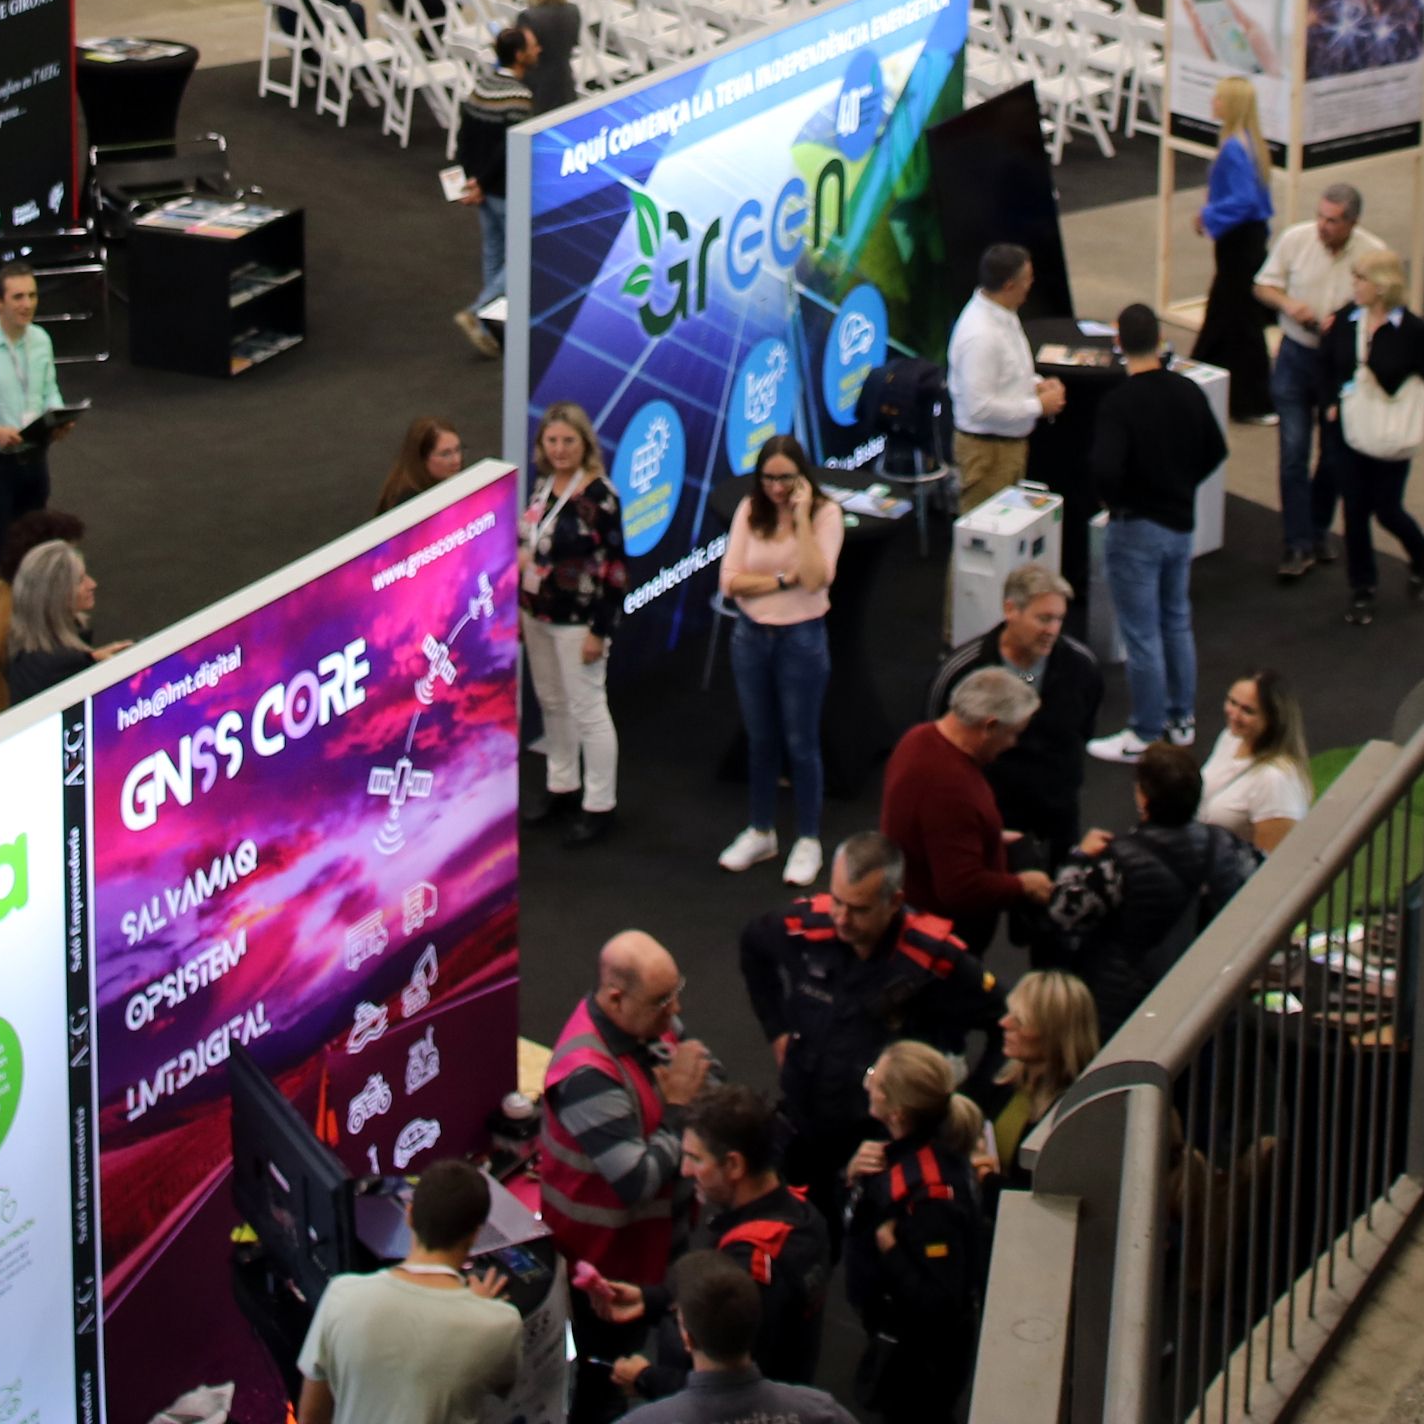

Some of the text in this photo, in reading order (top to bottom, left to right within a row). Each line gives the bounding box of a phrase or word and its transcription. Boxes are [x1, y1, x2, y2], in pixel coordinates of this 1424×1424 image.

[560, 126, 609, 177] AQUÍ
[692, 89, 716, 120] LA
[715, 71, 755, 109] TEVA
[371, 510, 496, 592] www.gnsscore.com
[116, 644, 242, 732] hola@lmt.digital
[120, 636, 372, 833] GNSS CORE
[120, 837, 258, 947] SALVAMAQ
[124, 929, 247, 1032] OPSISTEM
